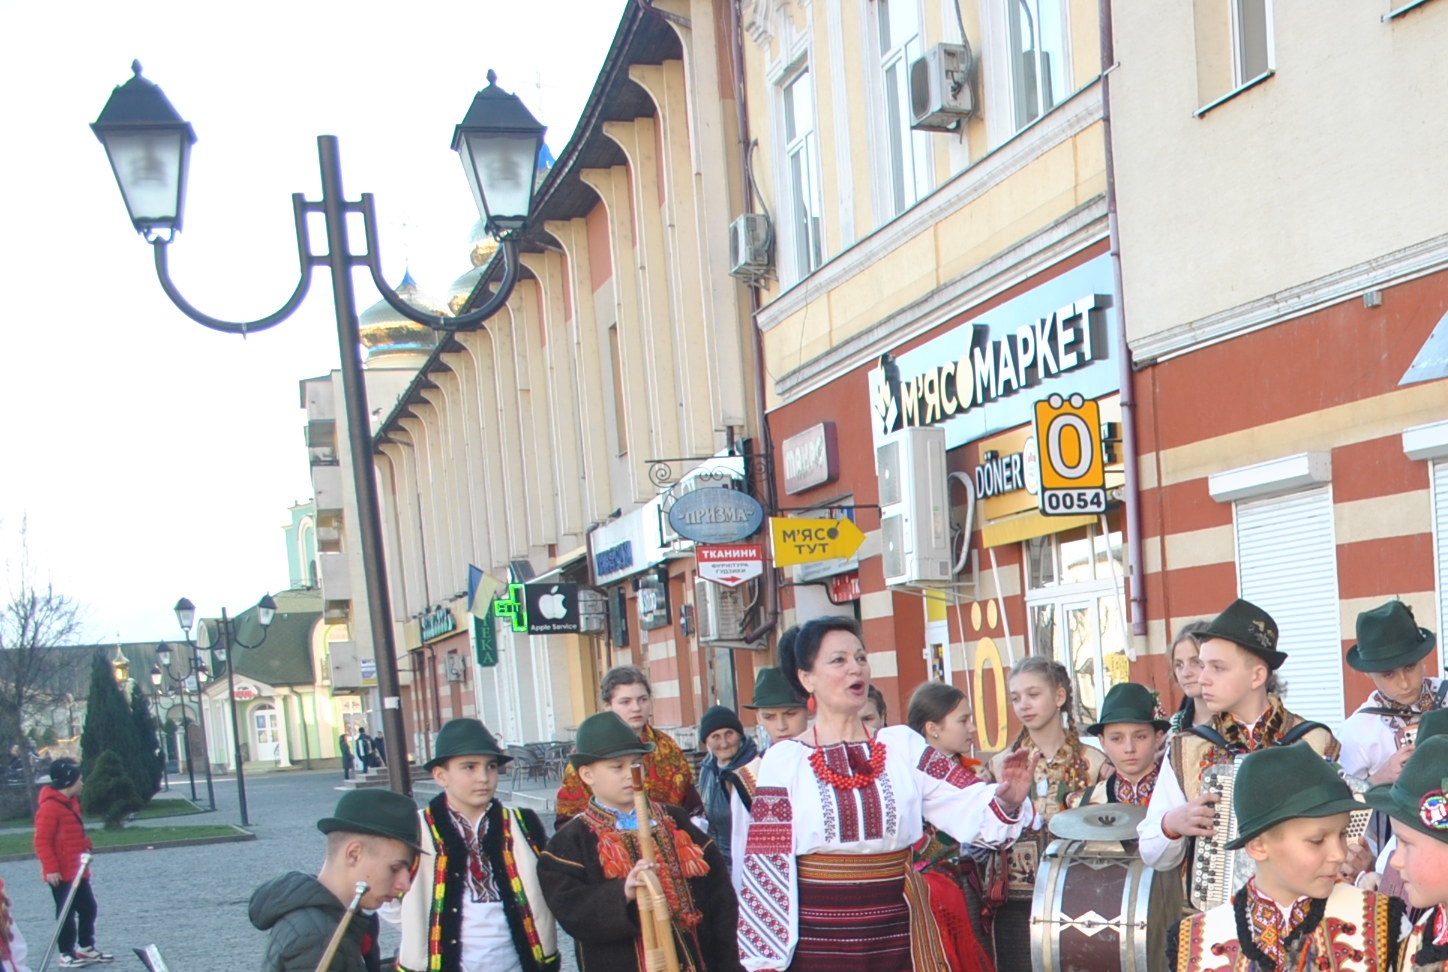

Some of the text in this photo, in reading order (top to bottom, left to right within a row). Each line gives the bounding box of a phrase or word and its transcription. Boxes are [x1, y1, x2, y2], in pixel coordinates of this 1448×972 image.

[975, 450, 1026, 500] DÖNER
[1047, 490, 1103, 511] 0054
[702, 549, 757, 559] ТКАНИНИ
[794, 543, 830, 555] ТУТ
[530, 622, 578, 632] Apple Service
